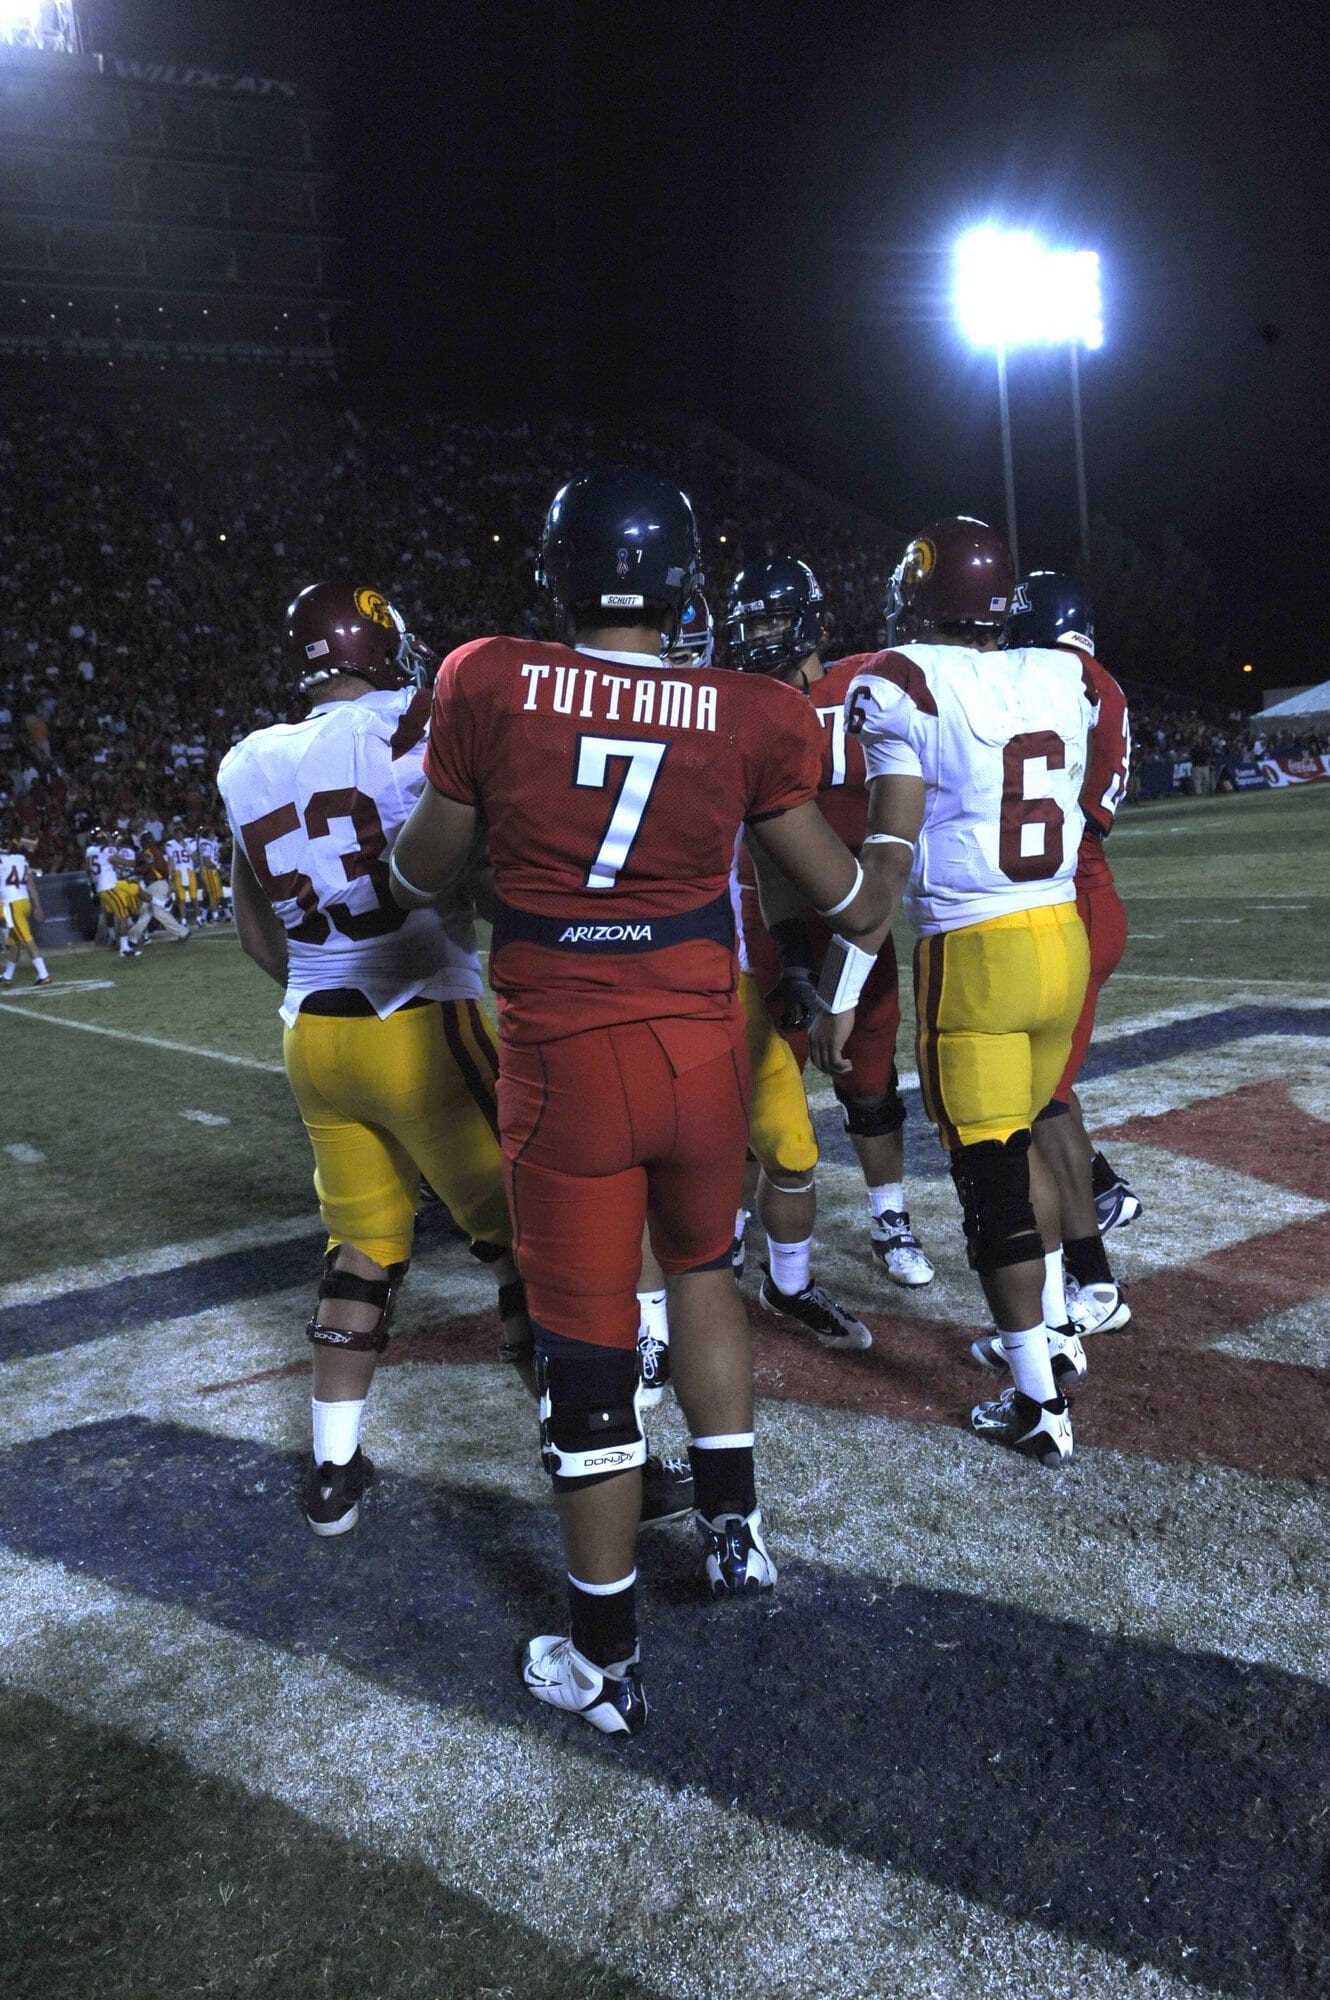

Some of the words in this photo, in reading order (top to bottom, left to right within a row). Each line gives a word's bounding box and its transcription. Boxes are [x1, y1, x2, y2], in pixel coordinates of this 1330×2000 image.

[607, 595, 638, 605] SCHUTT
[520, 663, 718, 732] TUITAMA
[848, 685, 872, 734] 6
[573, 734, 670, 889] 7
[999, 730, 1065, 882] 6
[240, 787, 411, 942] 53
[558, 925, 653, 943] ARIZONA
[583, 1451, 636, 1467] DONJOY
